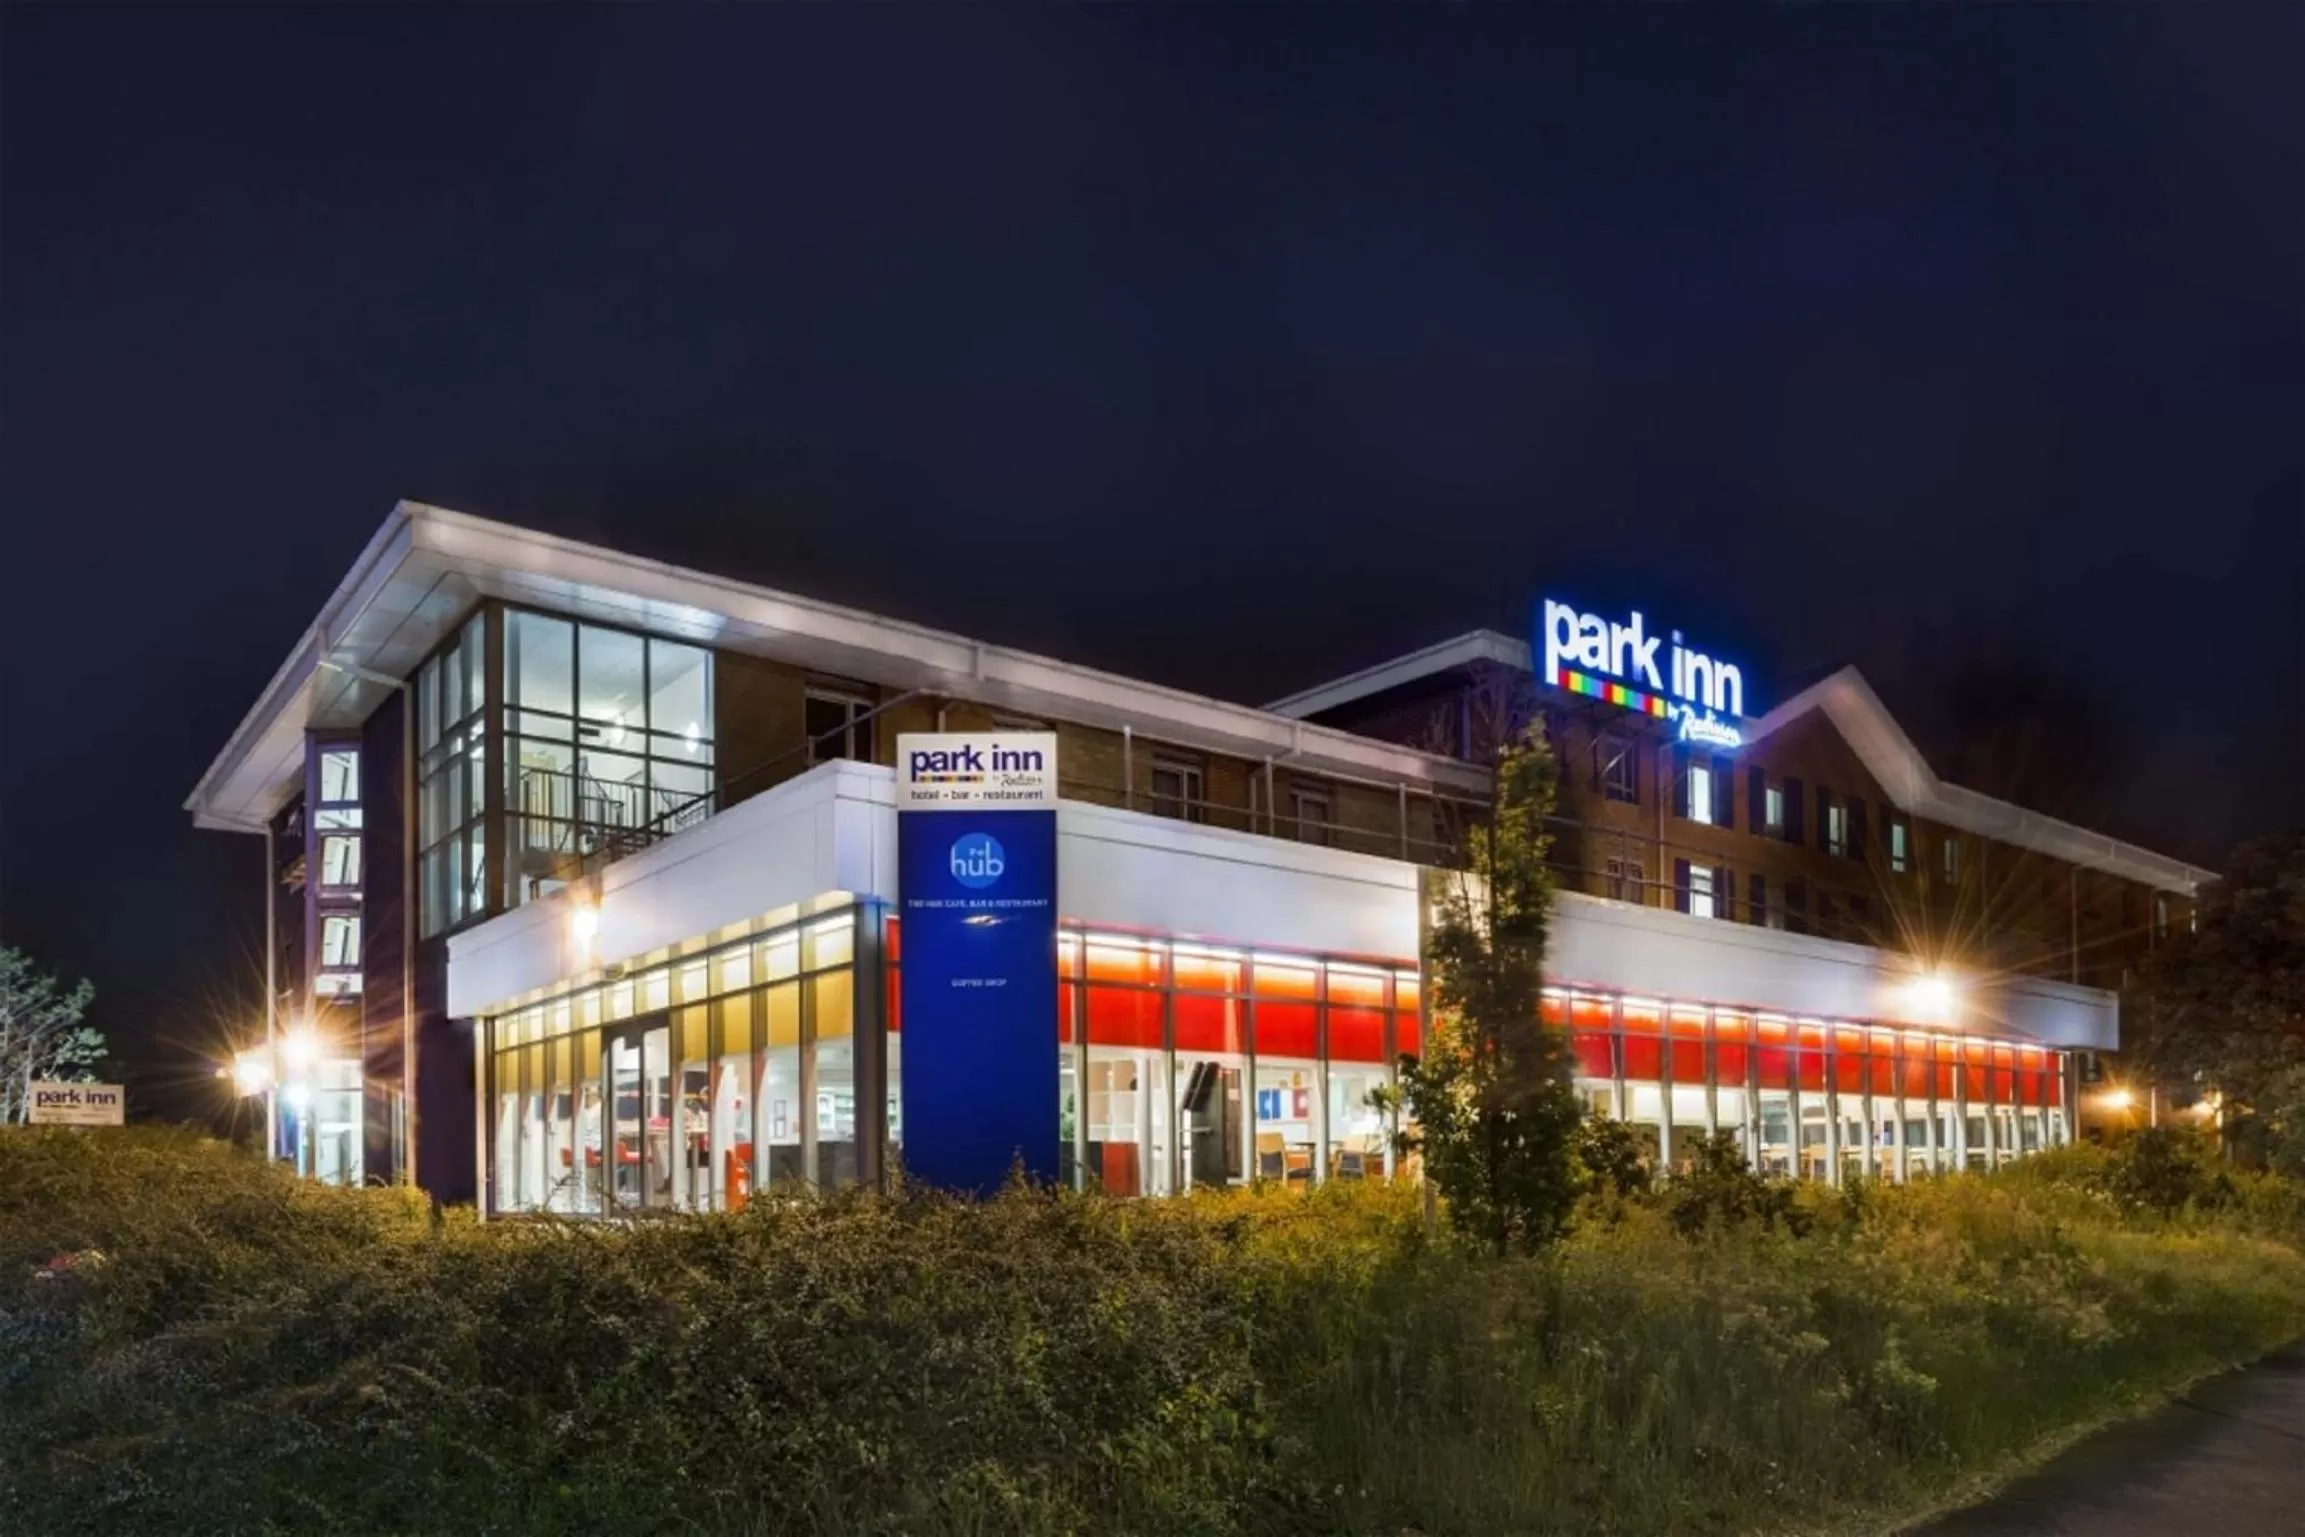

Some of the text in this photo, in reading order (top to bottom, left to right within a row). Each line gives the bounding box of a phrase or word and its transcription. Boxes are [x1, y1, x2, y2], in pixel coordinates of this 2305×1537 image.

[1545, 598, 1743, 717] park inn
[911, 744, 1043, 782] park inn
[911, 790, 1043, 800] hotel bar restaurant
[36, 1088, 116, 1108] park inn
